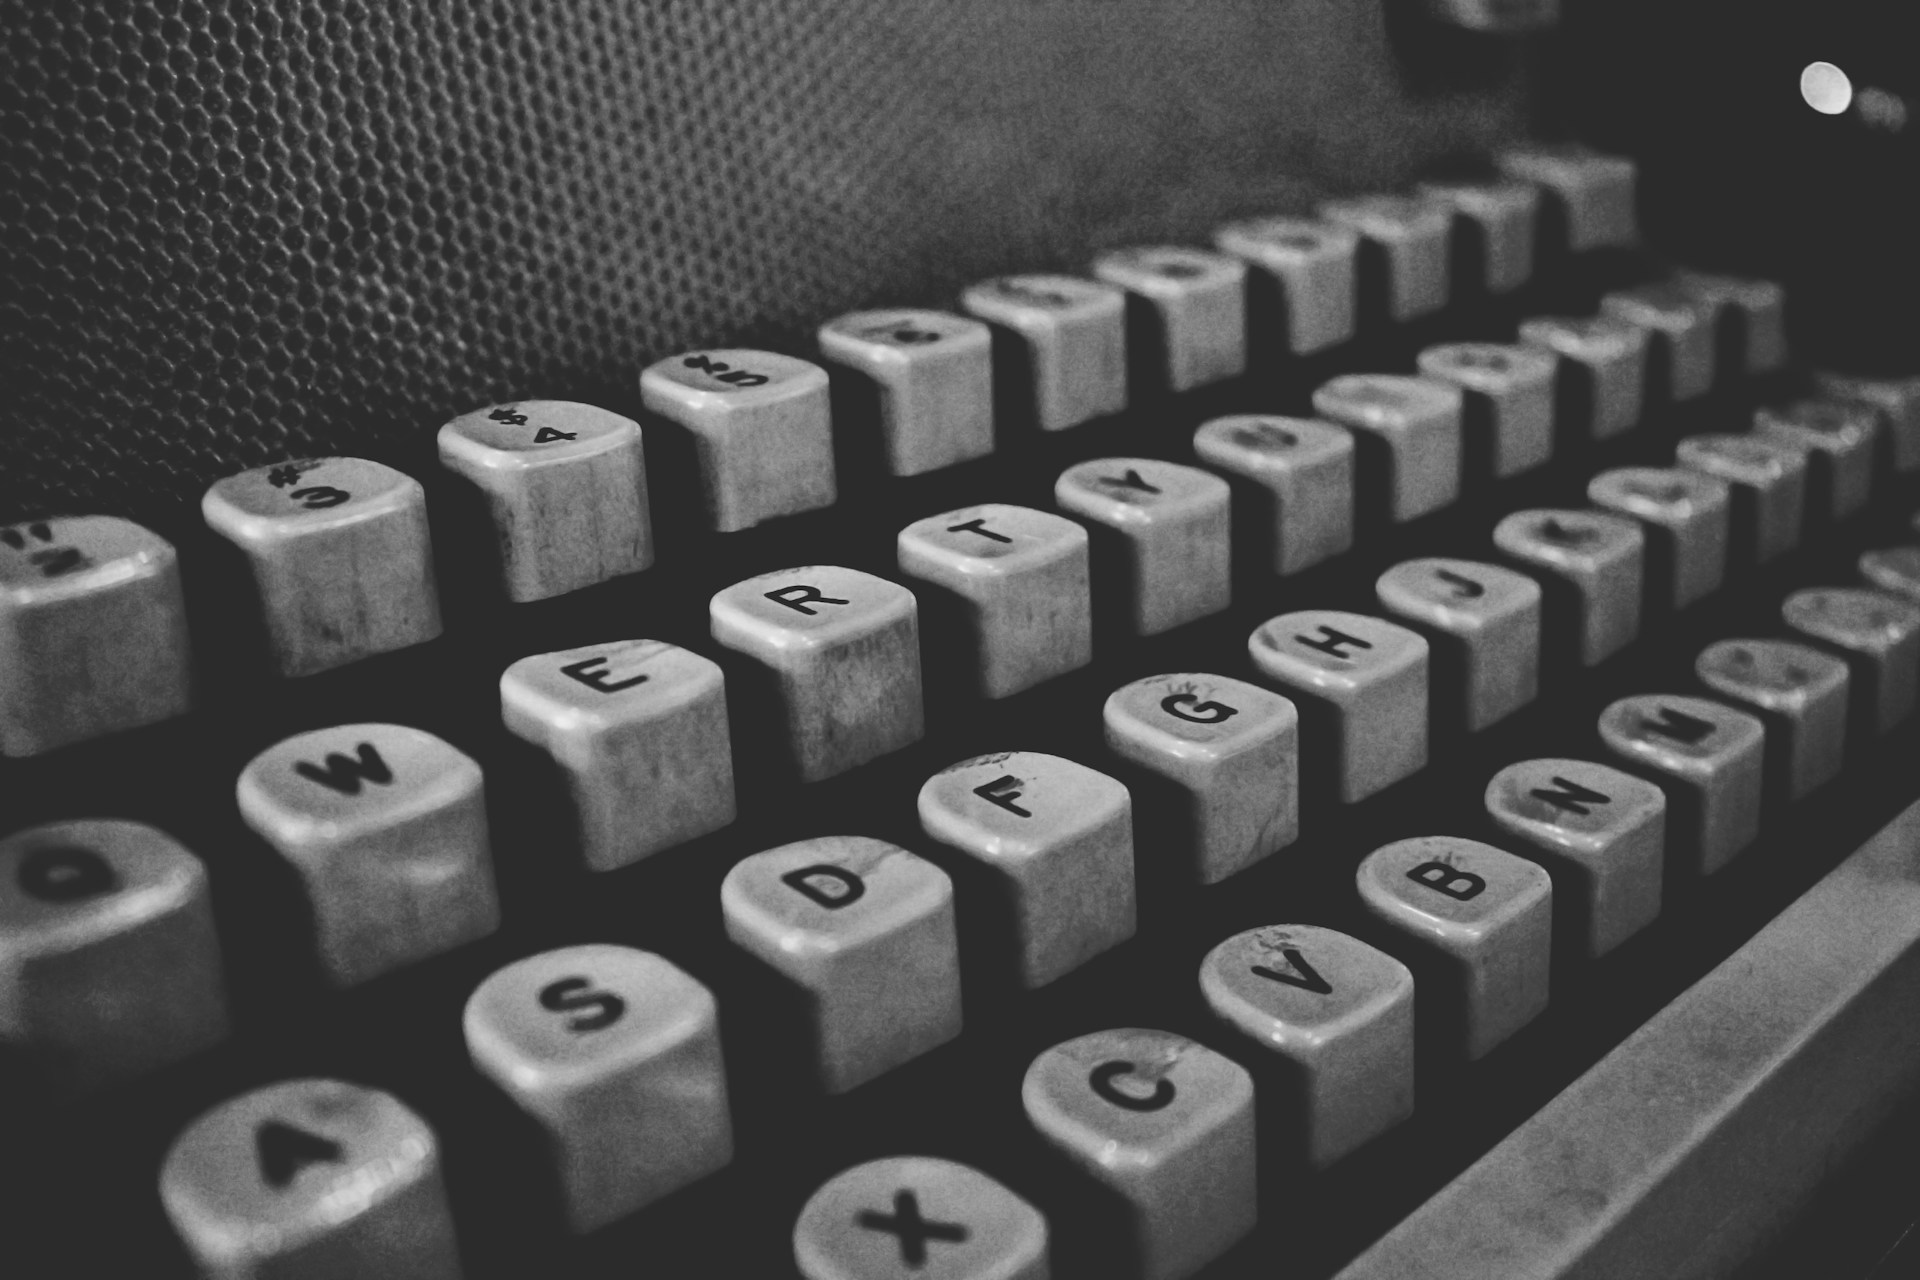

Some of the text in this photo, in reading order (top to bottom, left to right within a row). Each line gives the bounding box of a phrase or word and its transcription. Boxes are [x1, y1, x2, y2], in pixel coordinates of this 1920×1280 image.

[534, 427, 577, 443] 4
[290, 486, 350, 509] 3
[1099, 470, 1161, 494] Y
[947, 519, 1012, 544] T
[764, 585, 848, 615] R
[1294, 626, 1372, 659] H
[562, 657, 647, 693] E
[1161, 692, 1238, 724] G
[295, 740, 393, 796] W
[973, 775, 1032, 816] F
[1529, 776, 1611, 815] N
[783, 864, 866, 910] D
[1407, 861, 1487, 901] B
[1252, 949, 1333, 995] V
[538, 977, 627, 1034] S
[1089, 1060, 1175, 1112] C
[255, 1118, 343, 1191] A
[856, 1189, 970, 1269] X
